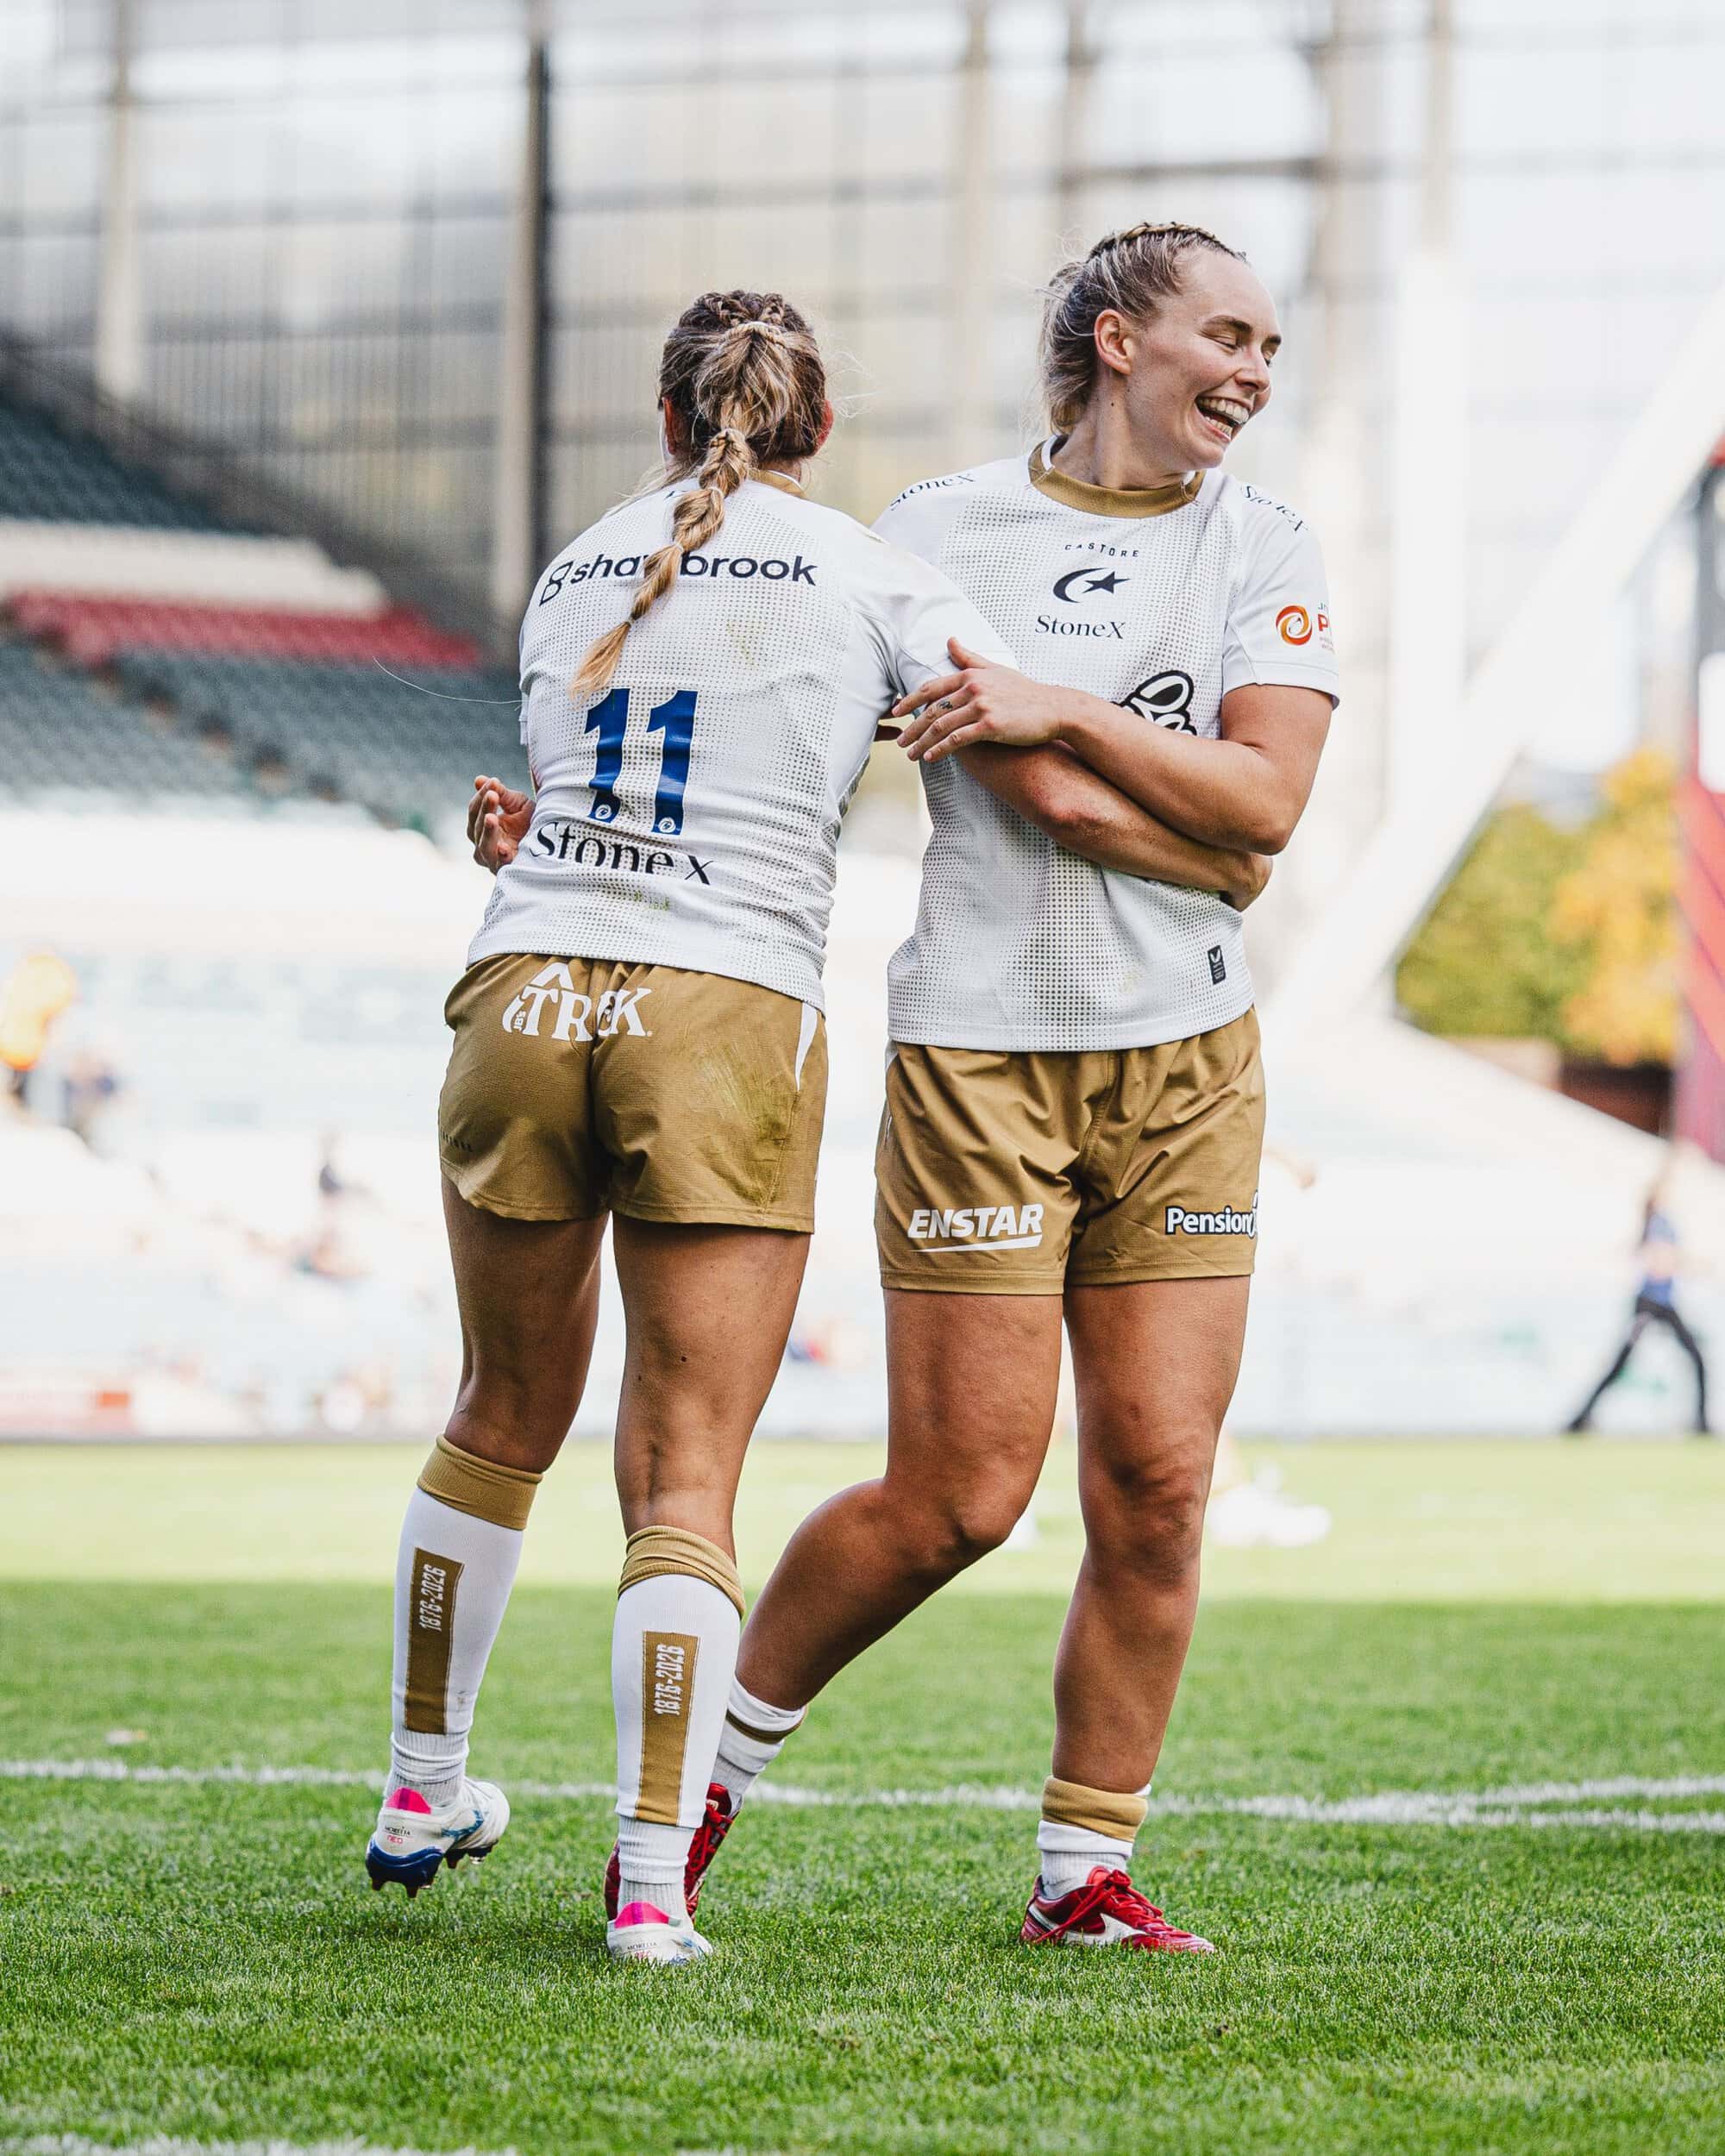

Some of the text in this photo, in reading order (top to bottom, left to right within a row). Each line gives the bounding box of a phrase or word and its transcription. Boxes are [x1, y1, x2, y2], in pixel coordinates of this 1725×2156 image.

[570, 553, 819, 586] shabrook
[1063, 542, 1140, 558] CASTORE
[1034, 614, 1126, 640] StoneX
[584, 687, 699, 837] 11
[529, 820, 714, 886] StoneX
[907, 1203, 1044, 1239] ENSTAR
[418, 1563, 448, 1633] 1876-2026
[653, 1643, 686, 1716] 1876-2026
